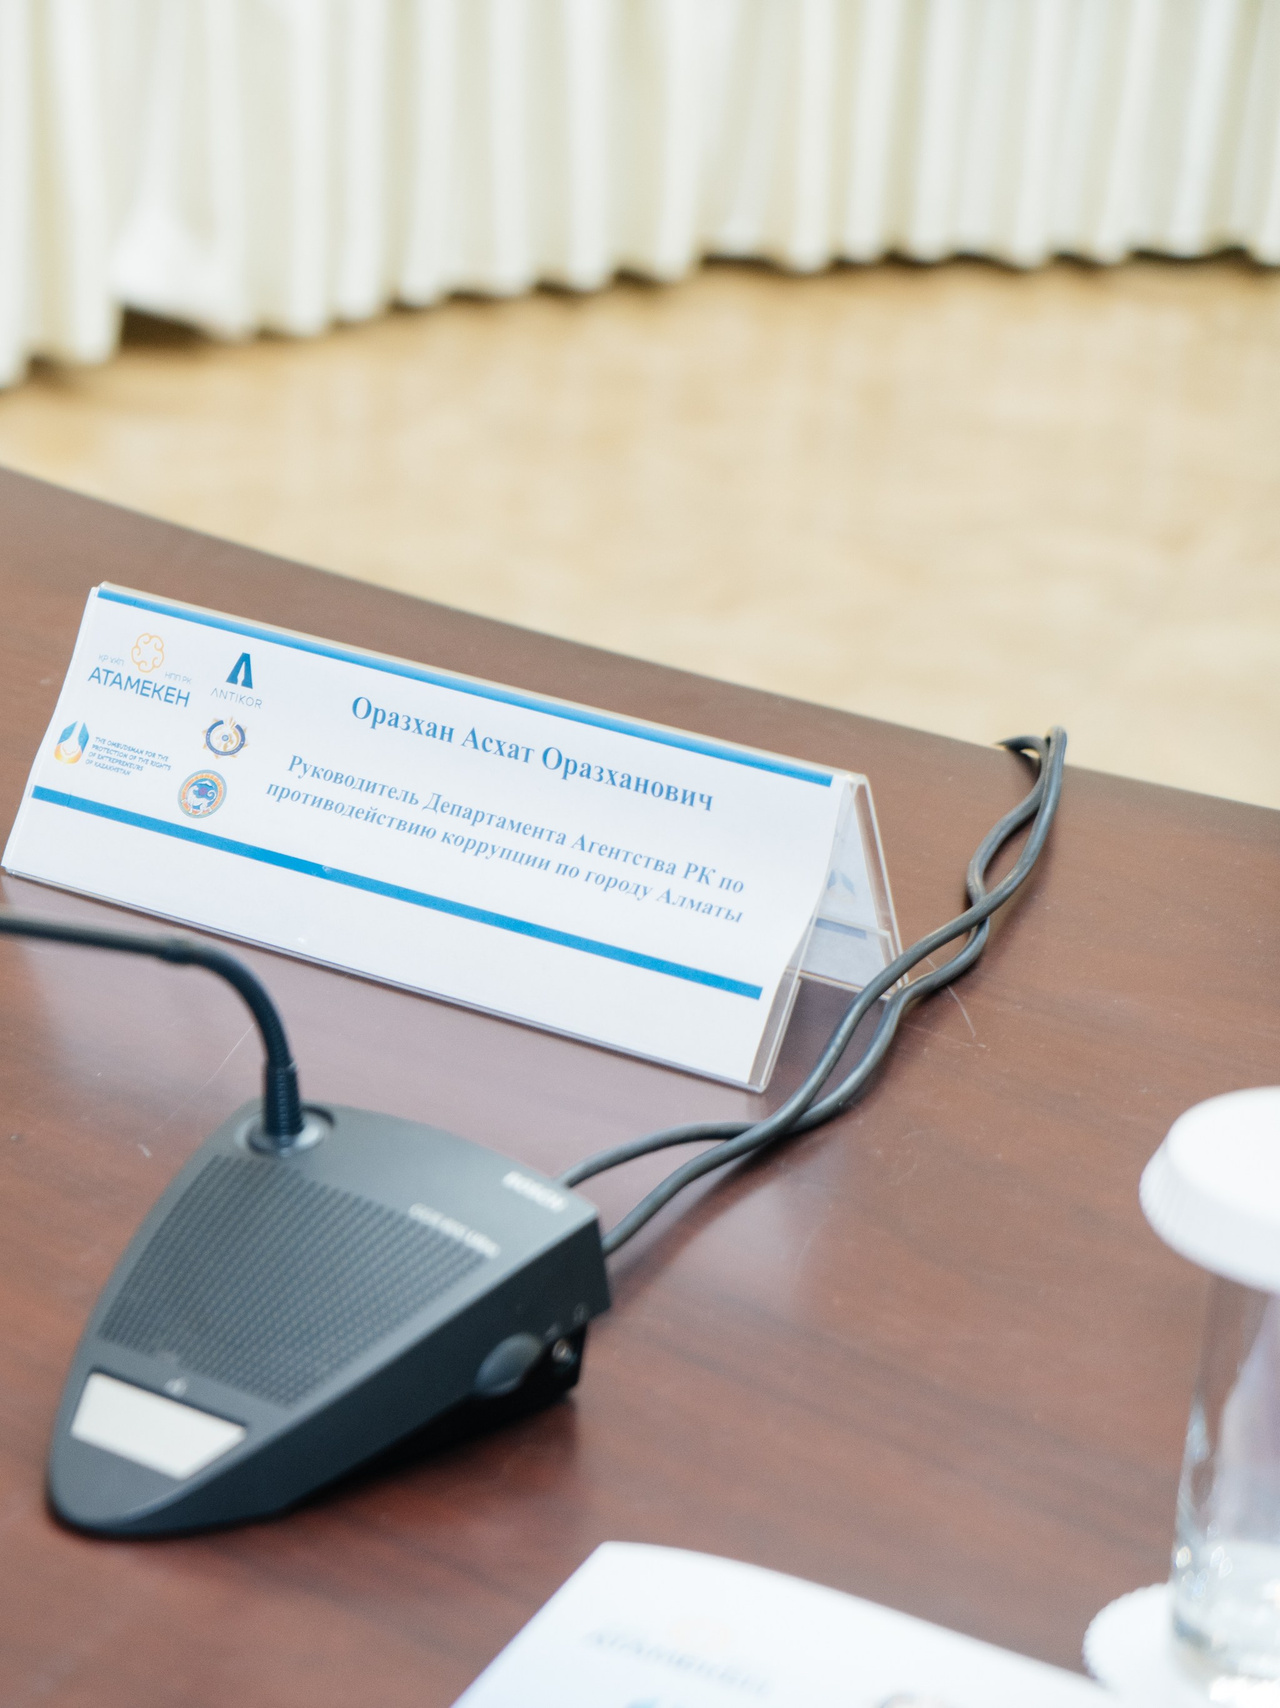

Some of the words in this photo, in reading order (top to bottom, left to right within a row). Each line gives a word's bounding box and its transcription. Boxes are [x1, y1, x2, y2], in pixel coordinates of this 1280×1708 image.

[87, 667, 191, 708] АТАМЕКЕН
[92, 744, 128, 759] PROTECTION
[95, 736, 106, 745] THE
[351, 695, 454, 745] Оразхан
[461, 726, 535, 764] Асхат
[542, 745, 714, 812] Оразханович
[265, 782, 438, 839] противодействию
[440, 830, 551, 873] коррупции
[554, 861, 580, 880] по
[584, 869, 653, 902] городу
[655, 888, 743, 924] Алматы
[288, 755, 420, 807] Руководитель
[422, 792, 566, 845] Департамента
[571, 833, 677, 876] Агентства
[682, 861, 717, 886] РК
[718, 876, 744, 894] по
